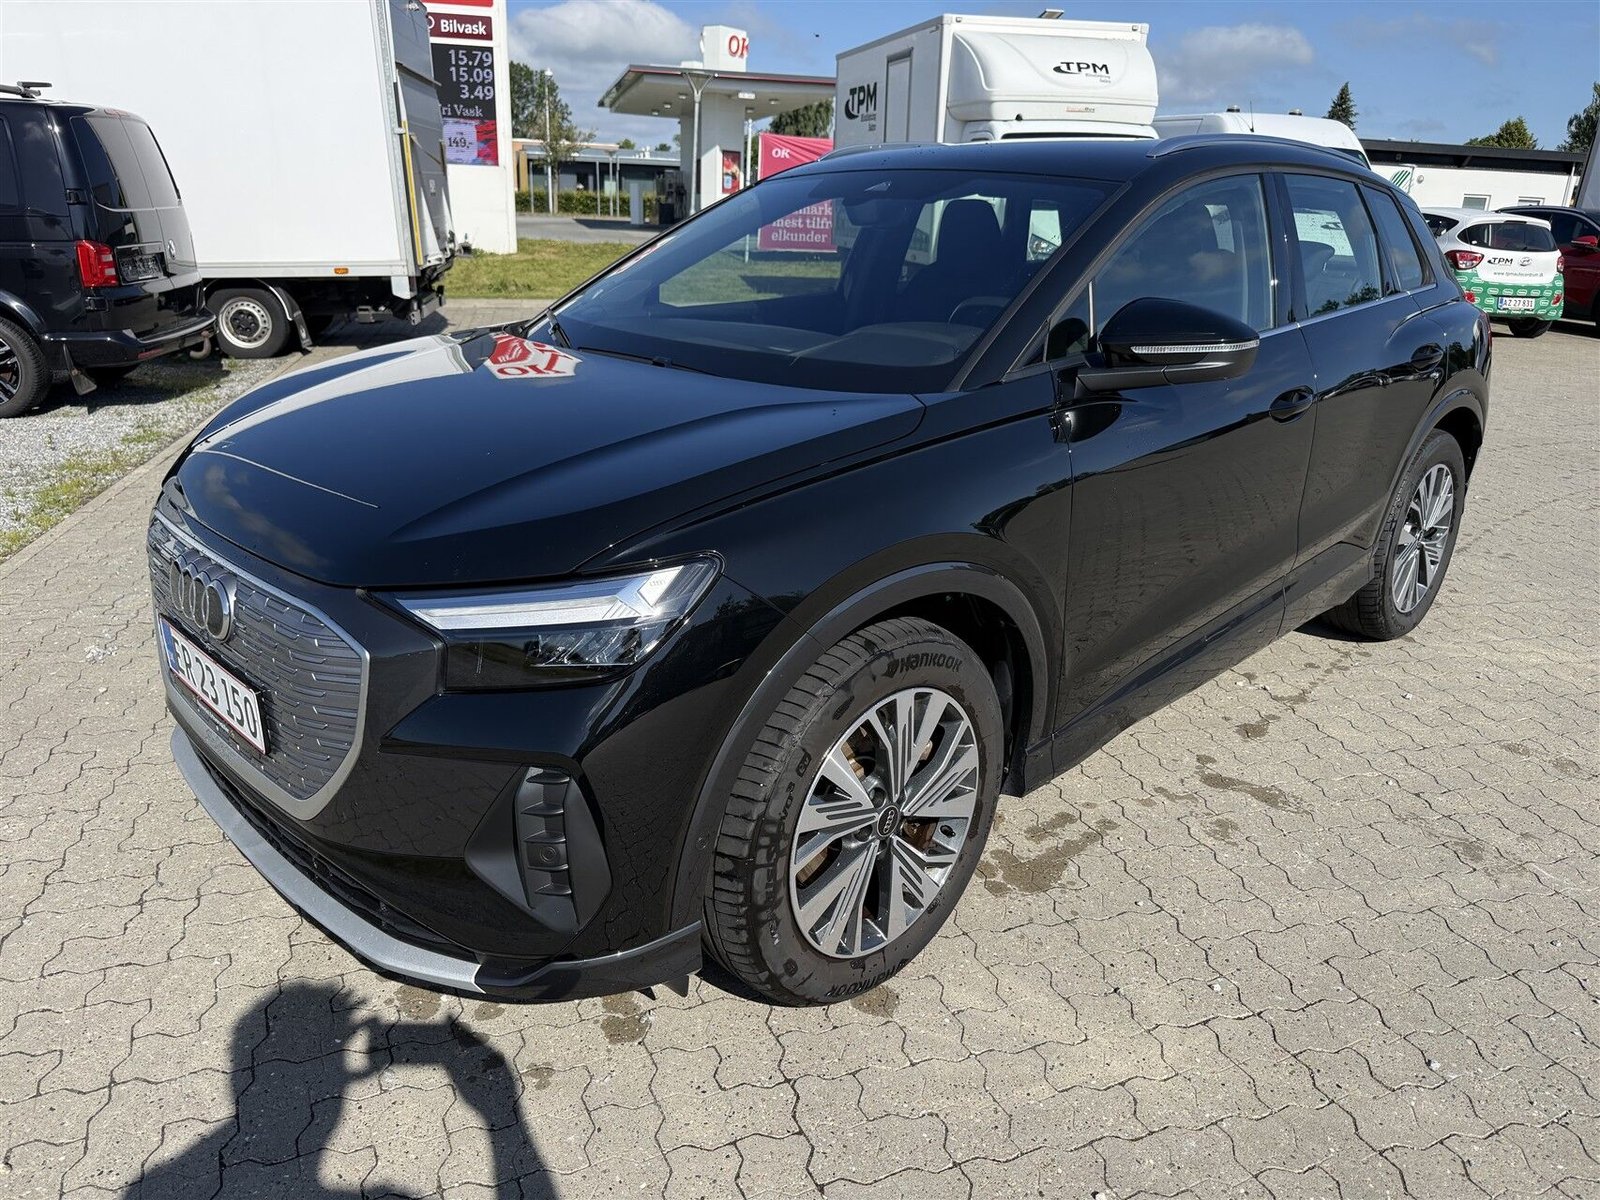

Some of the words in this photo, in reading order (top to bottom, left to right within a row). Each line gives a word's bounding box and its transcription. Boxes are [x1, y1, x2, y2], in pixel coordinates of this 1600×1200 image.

[440, 19, 487, 36] Bilvask
[448, 49, 493, 67] 15.79
[449, 66, 494, 84] 15.09
[1060, 61, 1110, 75] TPM
[459, 84, 495, 101] 3.49
[849, 81, 878, 115] TPM
[439, 103, 451, 116] ri
[453, 104, 484, 118] Vask
[771, 147, 790, 159] OK
[771, 230, 829, 243] elkunder
[1491, 257, 1514, 265] TPM
[172, 637, 198, 689] ER
[195, 656, 220, 706] 23
[221, 678, 258, 739] 150
